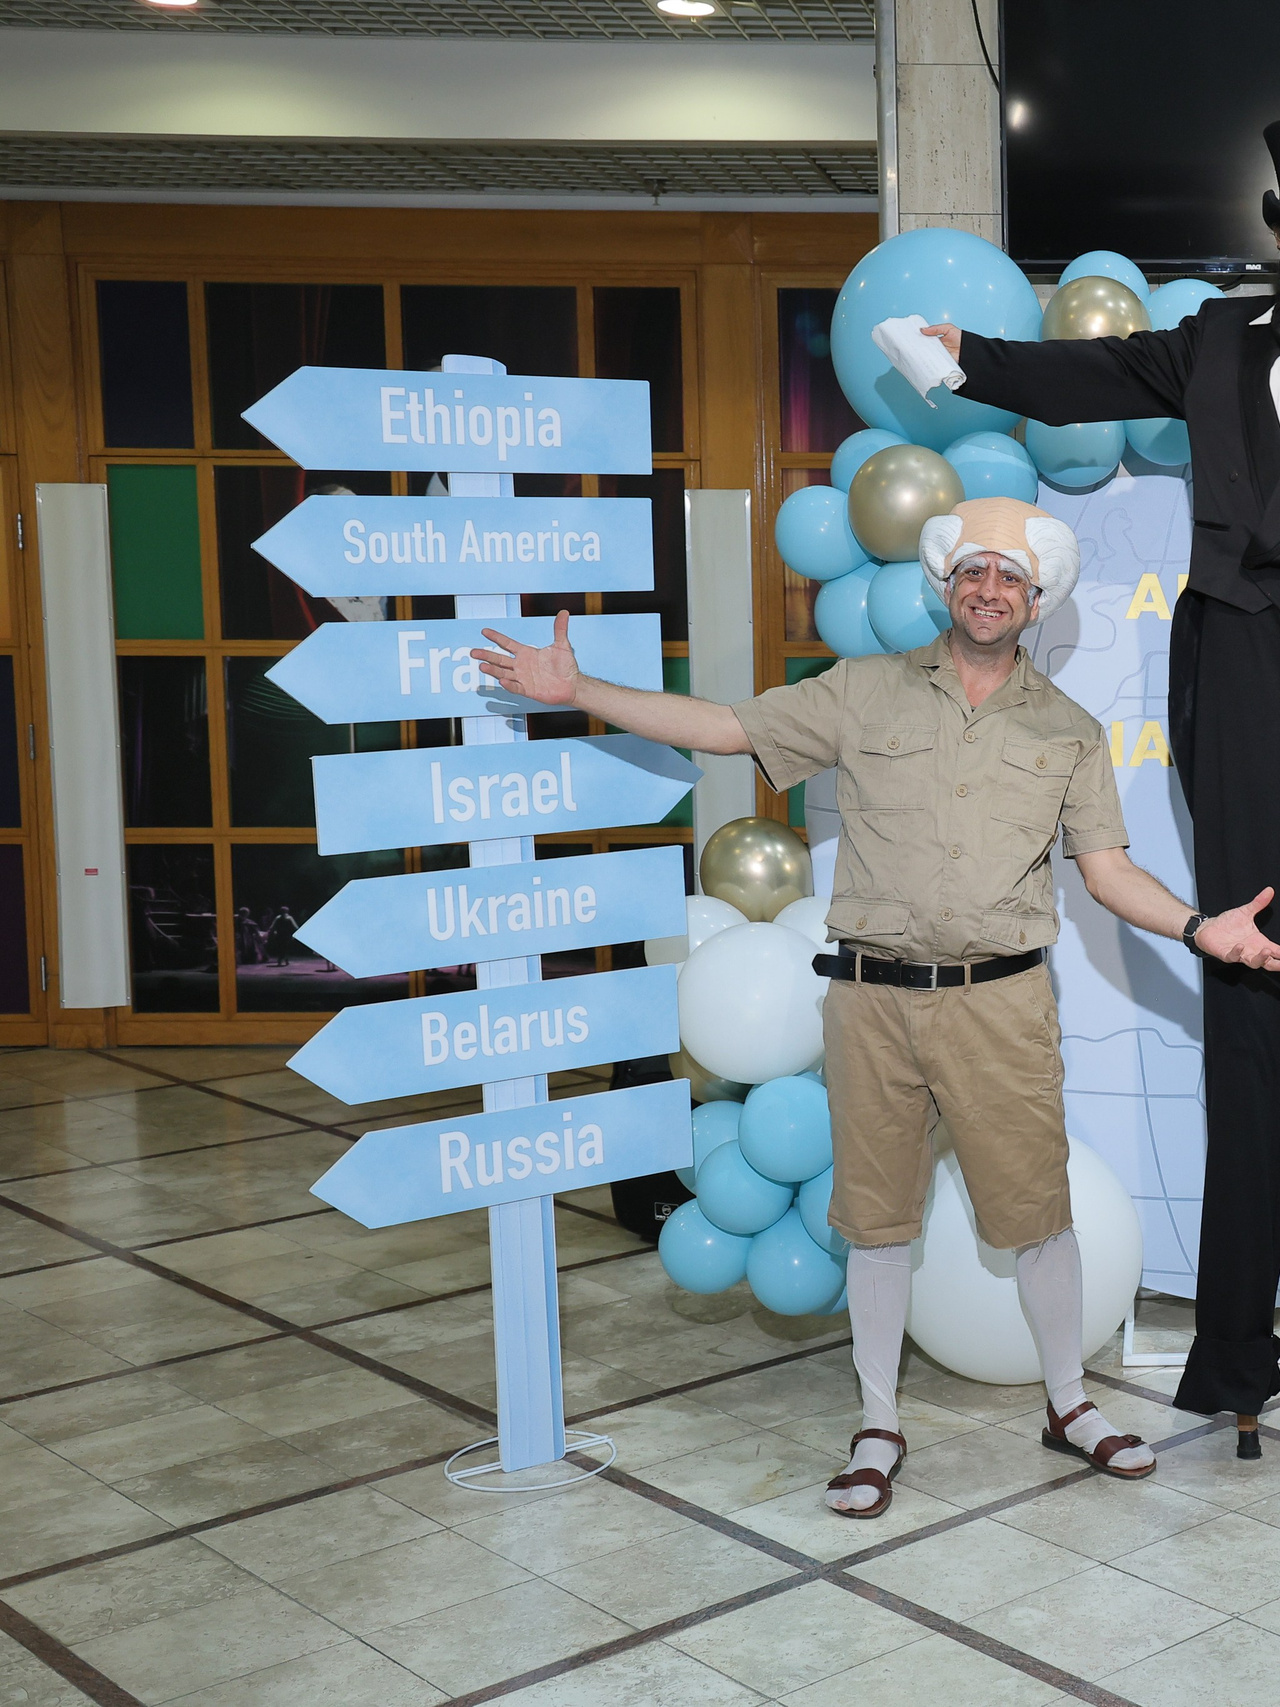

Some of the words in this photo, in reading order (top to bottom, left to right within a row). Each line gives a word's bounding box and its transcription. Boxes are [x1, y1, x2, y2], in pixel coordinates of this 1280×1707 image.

[379, 386, 563, 462] Ethiopia
[342, 518, 447, 564] South
[458, 519, 602, 563] America
[429, 751, 578, 824] Israel
[426, 876, 598, 942] Ukraine
[420, 1002, 590, 1067] Belarus
[438, 1111, 606, 1195] Russia
